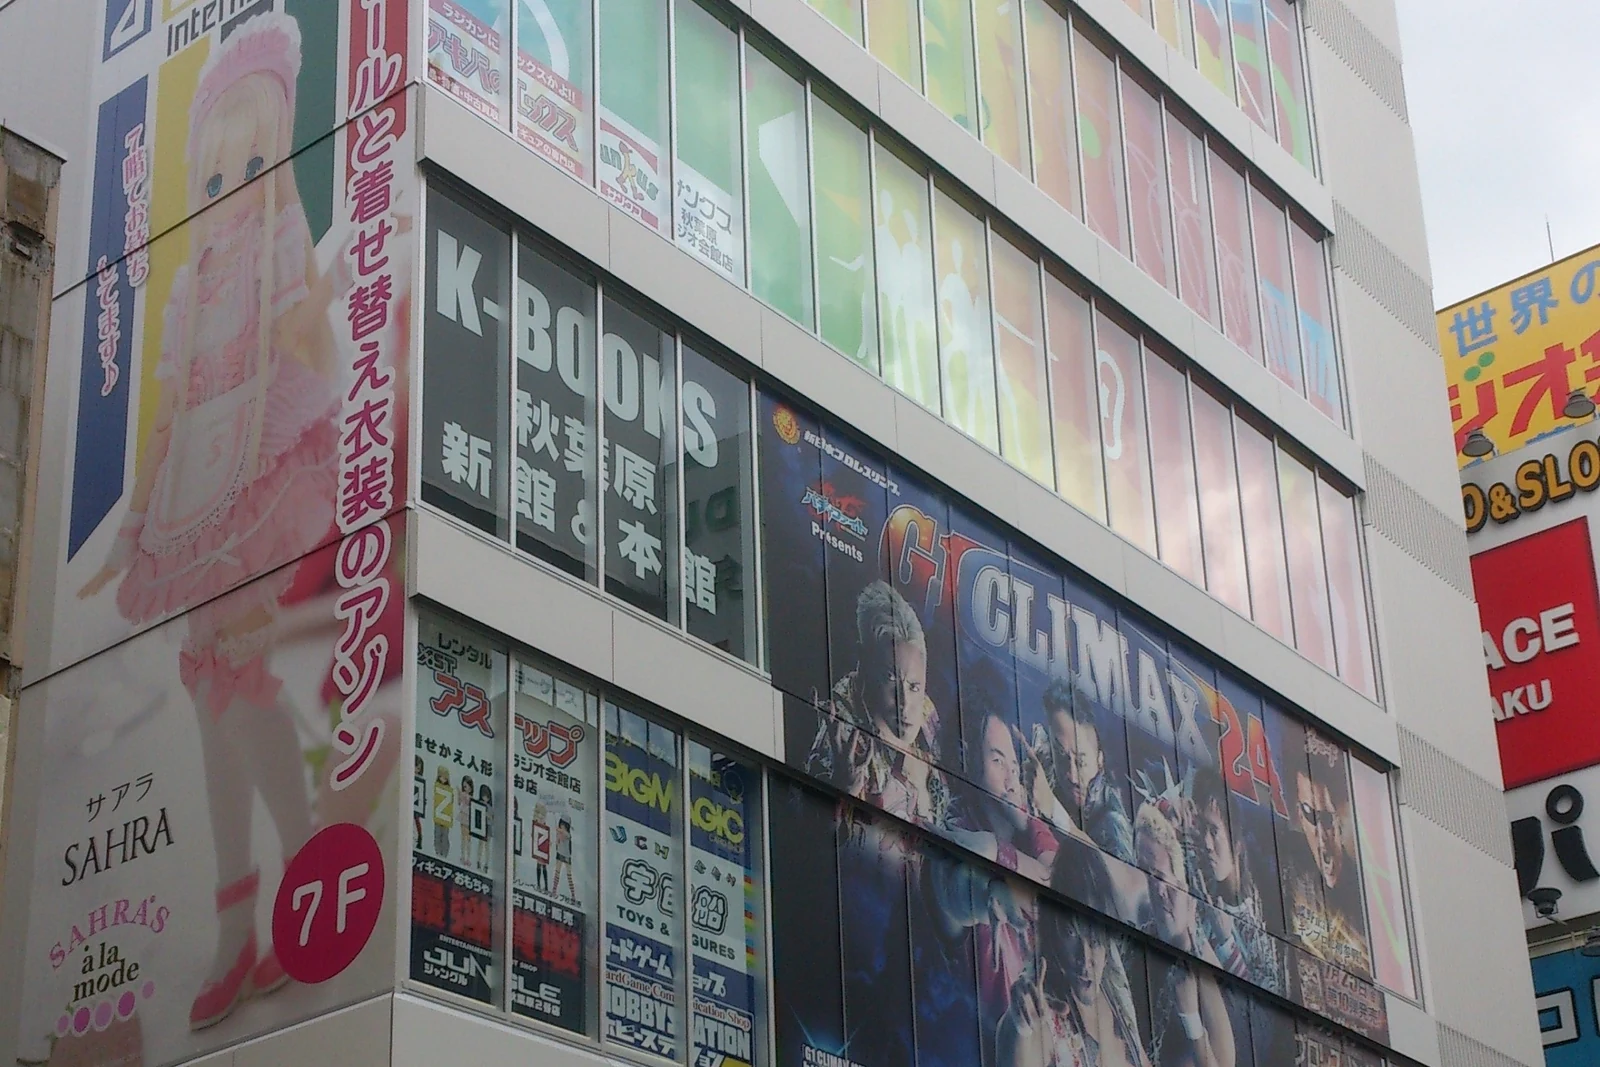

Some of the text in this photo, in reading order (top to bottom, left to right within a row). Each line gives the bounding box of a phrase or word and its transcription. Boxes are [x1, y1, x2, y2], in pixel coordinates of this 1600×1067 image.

[677, 223, 733, 273] ジオ会館店
[436, 229, 719, 469] K-BOOKS
[516, 389, 659, 516] 秋葉原
[1462, 439, 1600, 534] O&SLO
[811, 520, 864, 563] Presents
[438, 632, 493, 670] レンタル
[970, 563, 1214, 764] CLIMAX
[1206, 684, 1290, 821] 24
[86, 772, 154, 823] サアラ
[61, 806, 175, 887] SAHRA
[292, 861, 370, 947] 7F
[616, 904, 655, 931] TOYS
[660, 921, 671, 937] &
[72, 958, 140, 1003] mode
[98, 941, 121, 970] la
[728, 1011, 751, 1030] Shop
